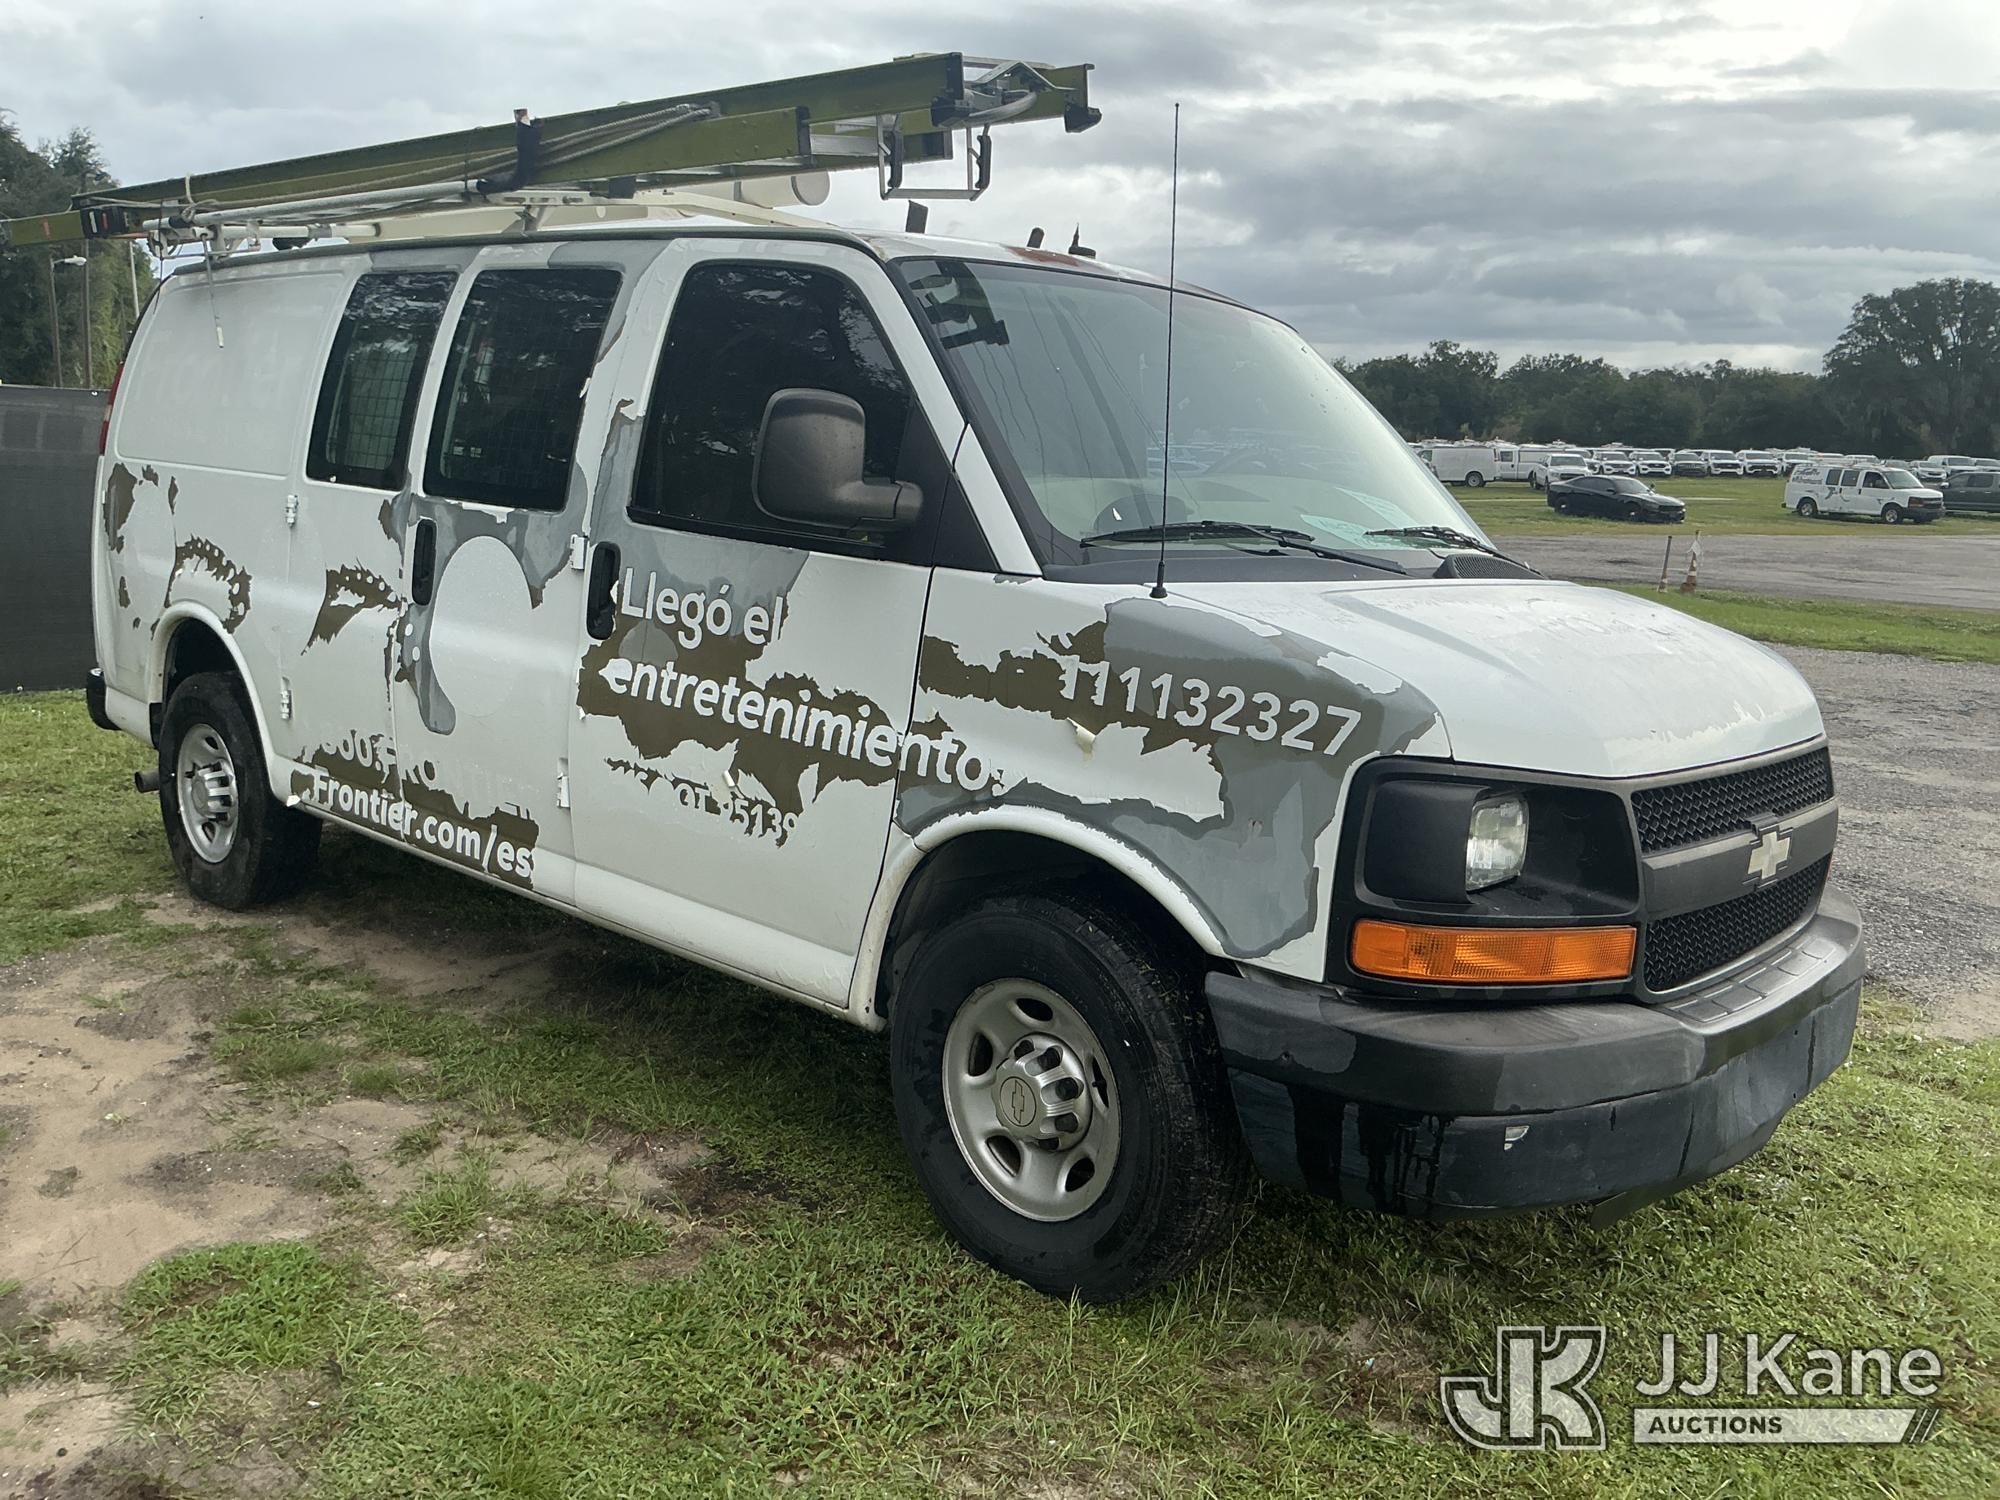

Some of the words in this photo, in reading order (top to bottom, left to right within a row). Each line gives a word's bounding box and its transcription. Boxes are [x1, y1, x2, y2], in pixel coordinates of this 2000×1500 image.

[620, 567, 733, 649] Llegó
[743, 596, 784, 643] el
[310, 766, 536, 878] Frontier.com/es
